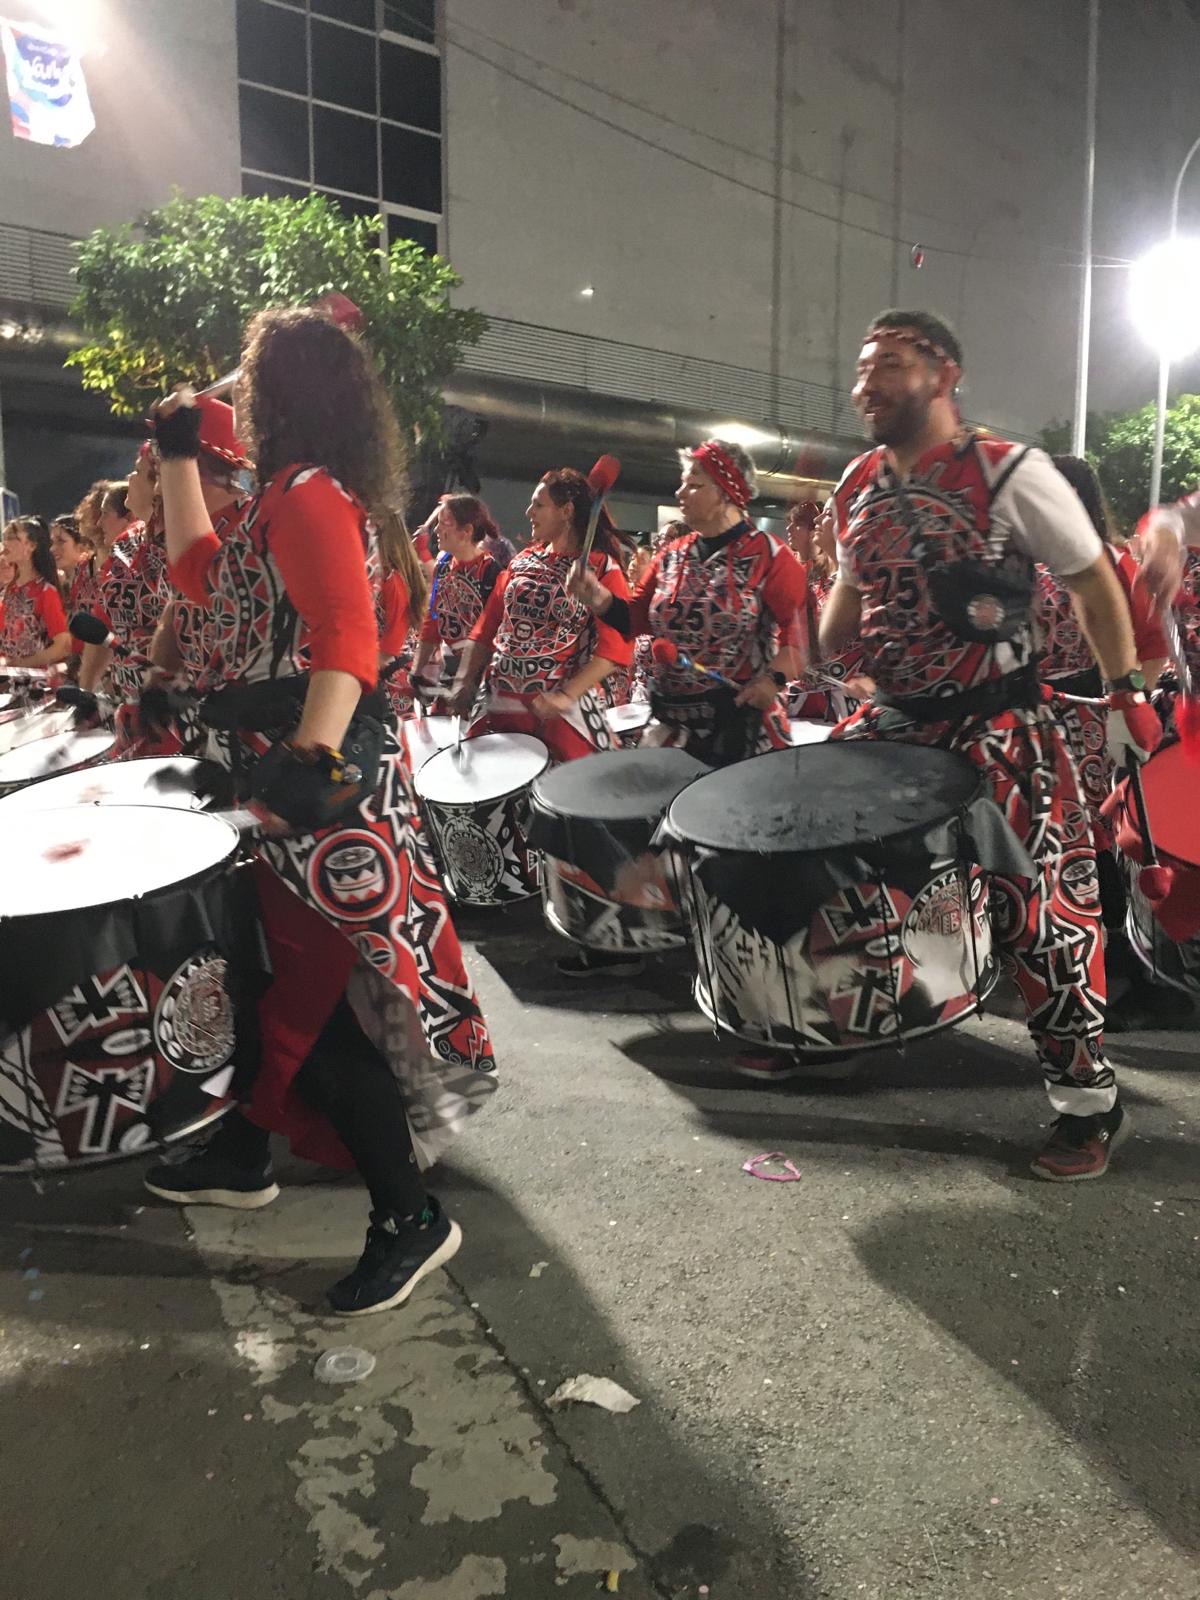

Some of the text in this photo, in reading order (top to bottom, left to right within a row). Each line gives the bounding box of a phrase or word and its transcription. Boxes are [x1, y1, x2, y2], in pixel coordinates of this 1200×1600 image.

[107, 581, 137, 610] 25
[516, 580, 552, 608] 25
[438, 613, 462, 639] 25
[667, 600, 705, 632] 25
[498, 656, 557, 678] UNDO
